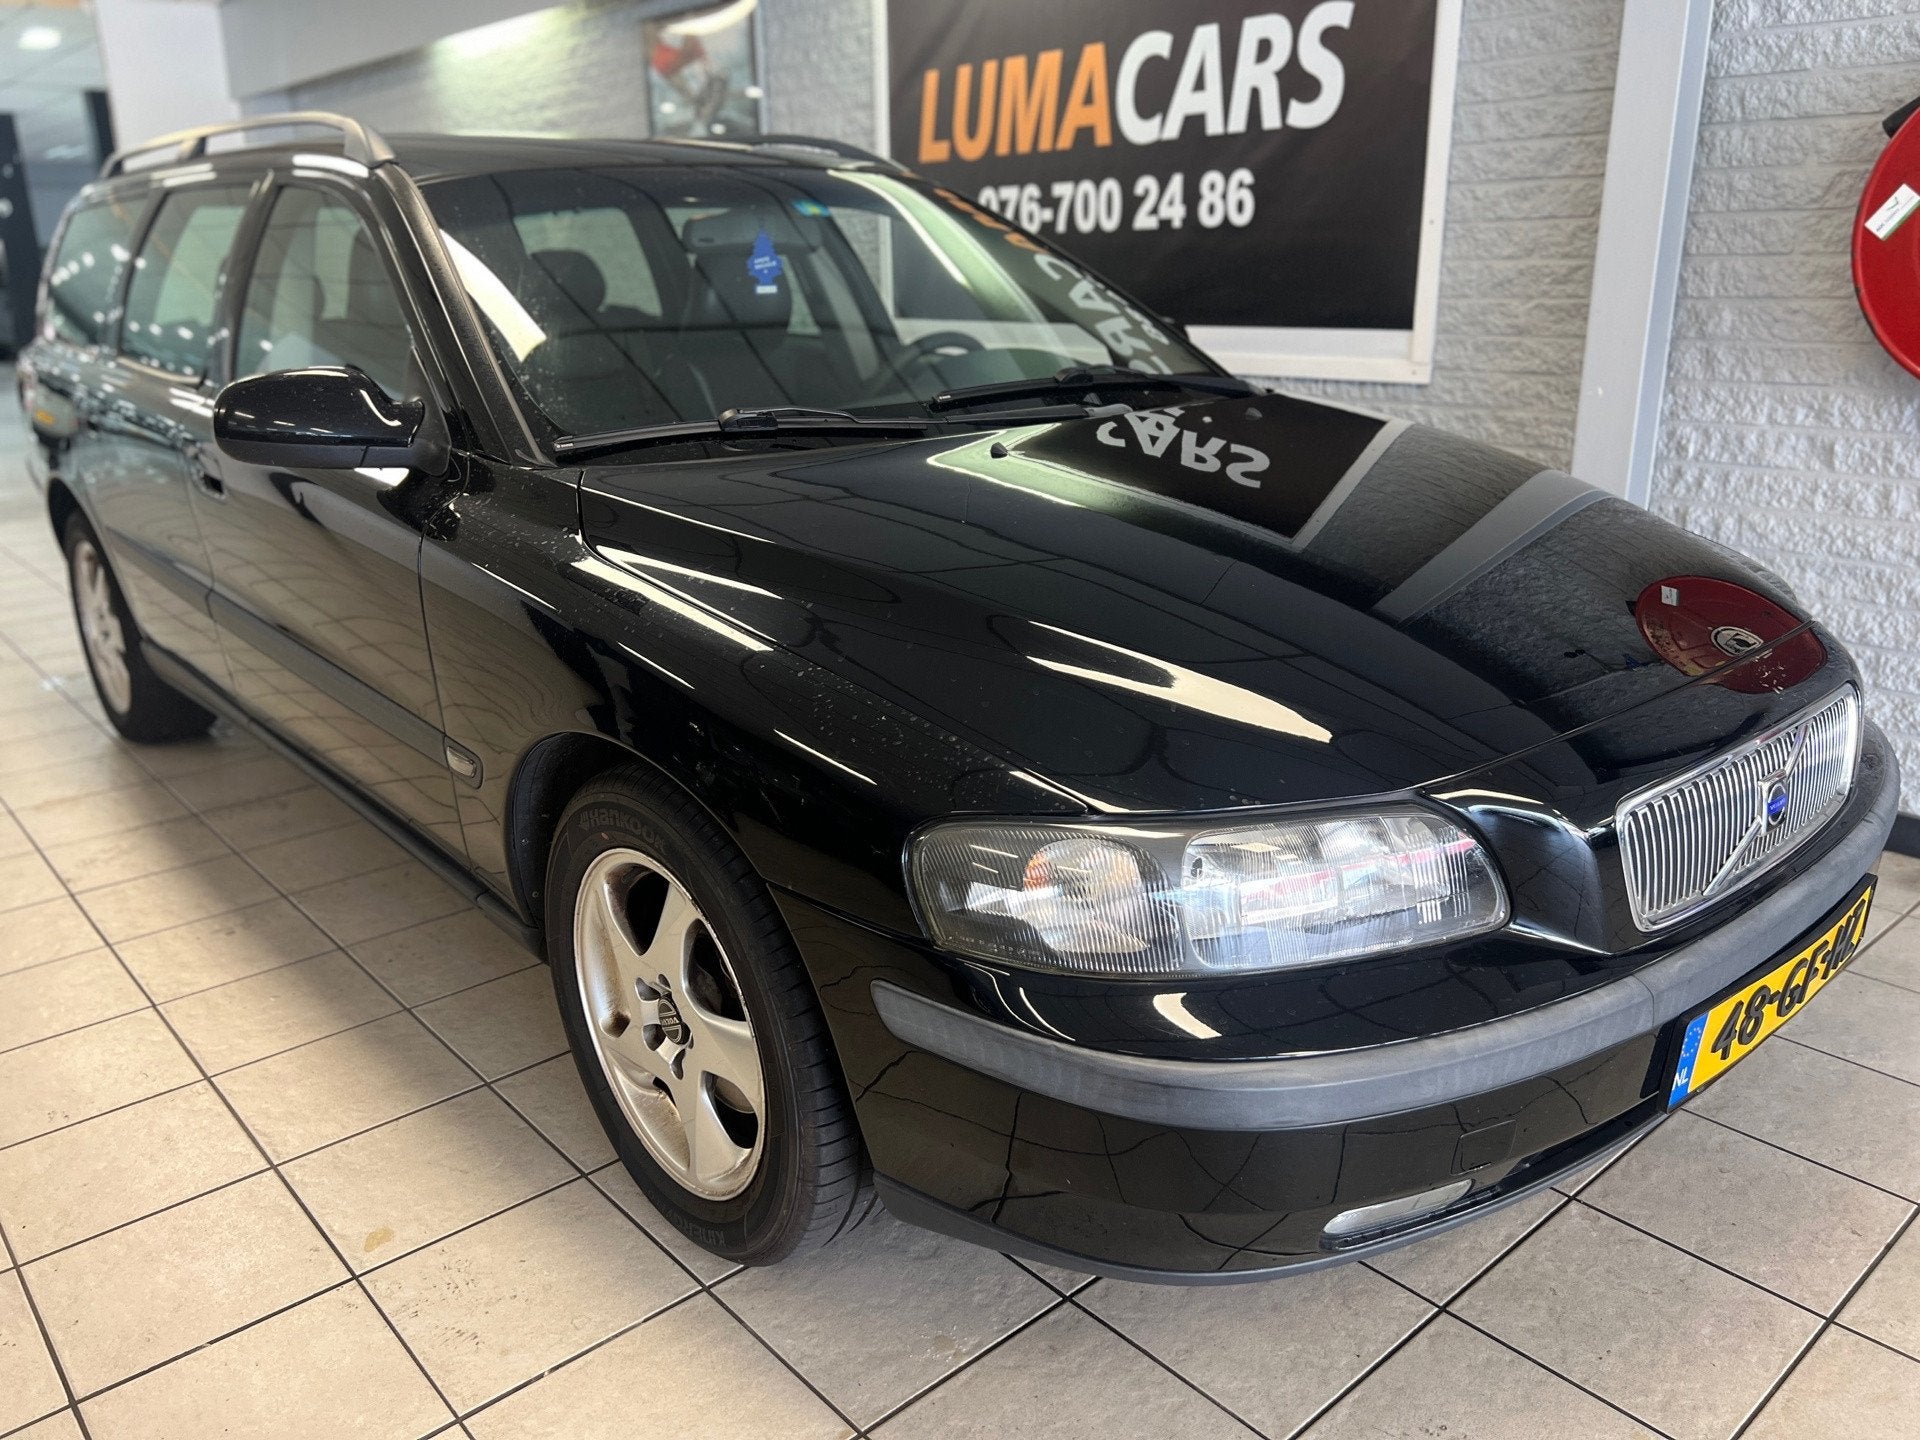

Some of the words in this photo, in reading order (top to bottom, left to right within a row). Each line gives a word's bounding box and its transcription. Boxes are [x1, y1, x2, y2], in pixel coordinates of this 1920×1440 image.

[918, 1, 1356, 164] LUMACARS
[1132, 172, 1186, 231] 24
[1198, 168, 1256, 228] 86
[1672, 1066, 1689, 1090] NL
